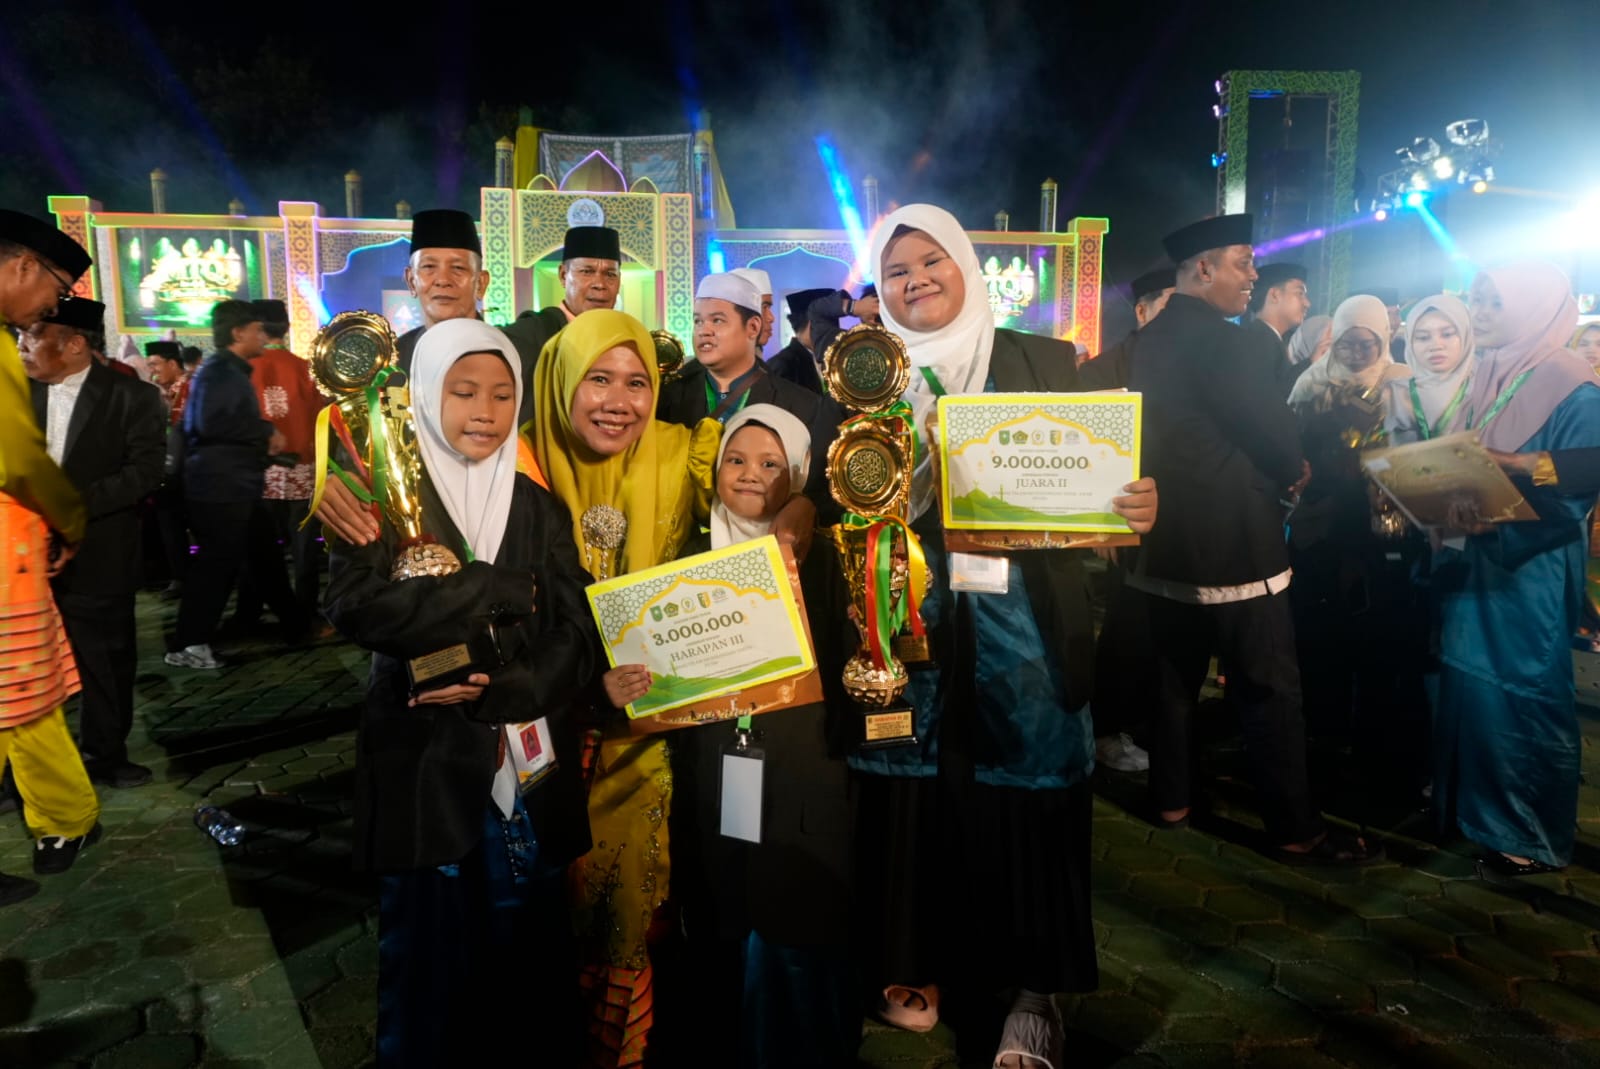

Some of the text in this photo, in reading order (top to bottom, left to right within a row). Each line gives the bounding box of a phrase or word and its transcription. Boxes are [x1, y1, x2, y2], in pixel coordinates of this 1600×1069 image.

[992, 456, 1089, 470] 9.000.000
[1015, 478, 1068, 489] JUARA II
[653, 611, 743, 646] 3.000.000
[670, 637, 729, 662] HARAPAN
[730, 634, 744, 645] III
